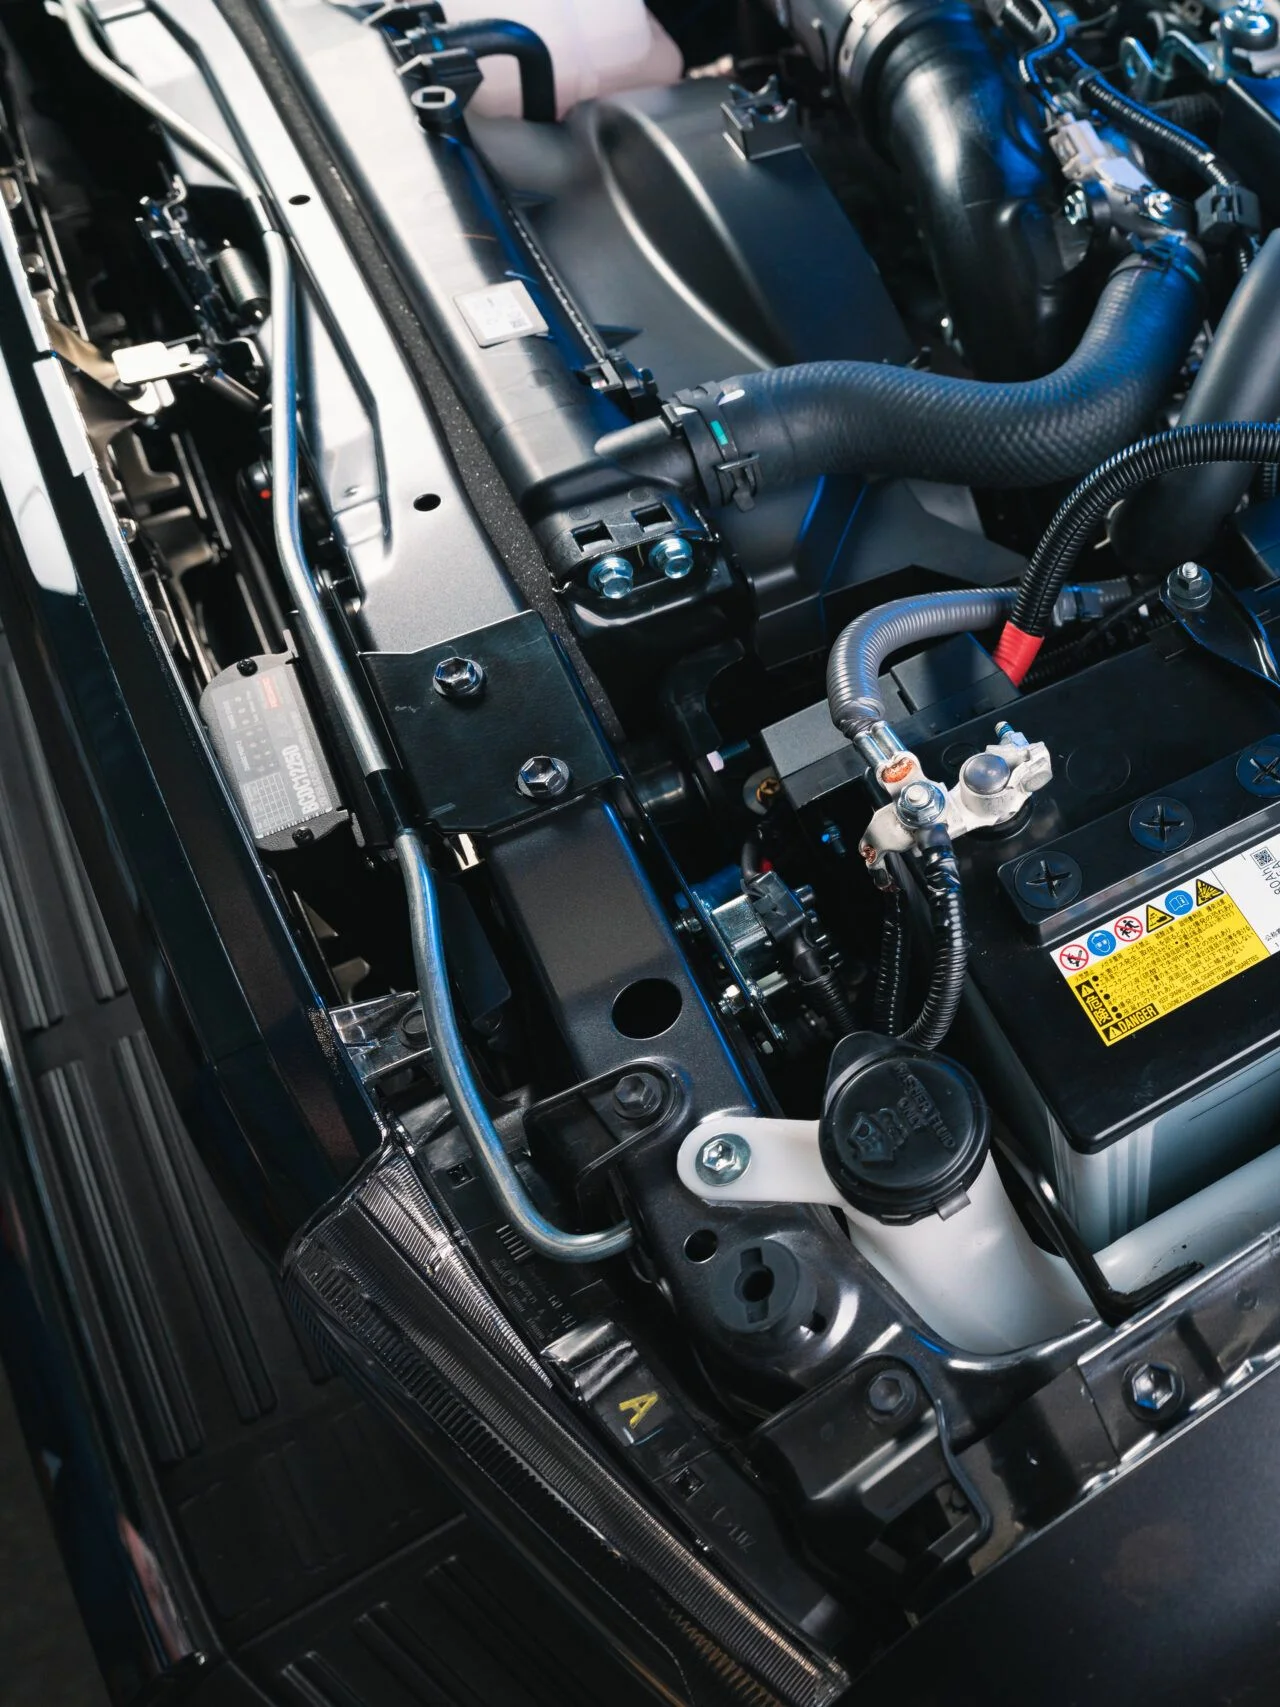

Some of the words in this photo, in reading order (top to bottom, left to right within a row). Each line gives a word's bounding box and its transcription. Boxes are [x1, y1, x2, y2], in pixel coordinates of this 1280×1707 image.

[1085, 994, 1111, 1024] 危険
[1118, 1005, 1157, 1033] DANGER
[927, 1111, 957, 1149] FLUID
[619, 1391, 659, 1429] A
